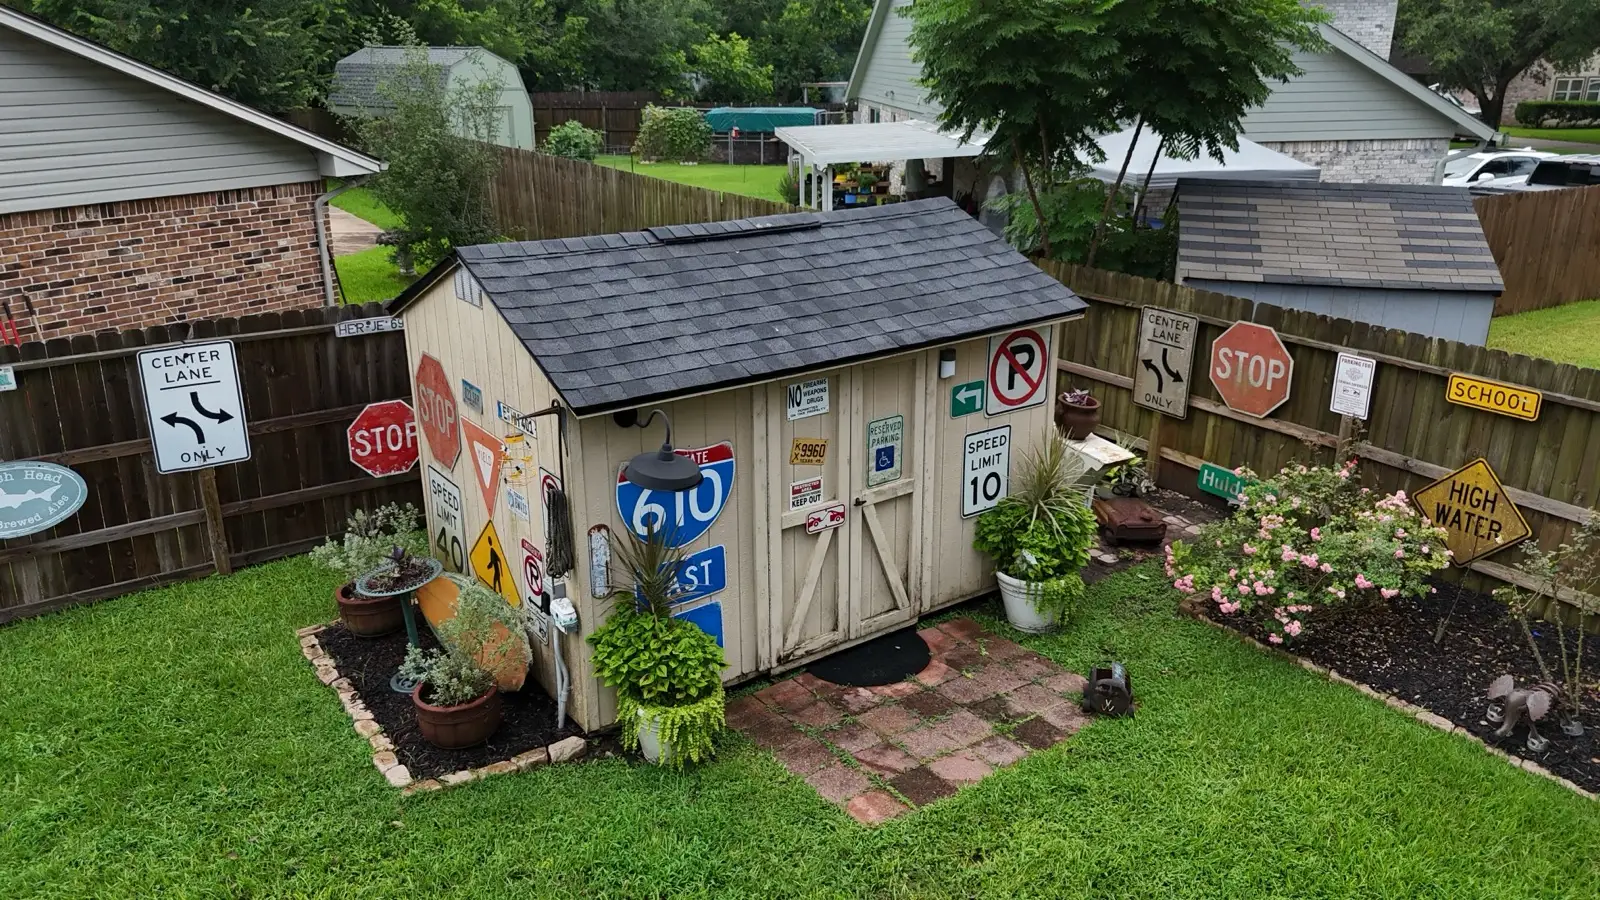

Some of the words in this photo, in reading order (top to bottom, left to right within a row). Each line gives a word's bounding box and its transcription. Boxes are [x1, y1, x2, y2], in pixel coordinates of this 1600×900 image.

[338, 322, 364, 336] HER
[1148, 314, 1190, 332] CENTER
[1152, 328, 1181, 344] LANE
[152, 350, 220, 369] CENTER
[1216, 347, 1285, 391] STOP
[165, 366, 212, 383] LANE
[802, 378, 827, 389] FIREARMS
[788, 385, 802, 409] NO
[802, 387, 827, 397] WEAPONS
[806, 396, 824, 405] DRUGS
[1144, 393, 1173, 409] ONLY
[1454, 382, 1532, 413] SCHOOL
[419, 383, 455, 439] STOP
[870, 421, 902, 436] RESERVED
[354, 421, 418, 457] STOP
[871, 433, 900, 448] PARKING
[968, 434, 1007, 454] SPEED
[180, 446, 226, 463] ONLY
[800, 443, 826, 458] 9960
[971, 453, 1002, 471] LIMIT
[23, 470, 63, 484] Head
[1202, 469, 1244, 496] Huld
[432, 480, 459, 512] SPEED
[971, 471, 1001, 506] 10
[1449, 480, 1498, 514] HIGH
[48, 495, 69, 516] Ales
[632, 469, 723, 536] 610
[791, 497, 808, 508] KEEP
[808, 494, 821, 504] OUT
[436, 501, 457, 531] LIMIT
[1436, 502, 1502, 541] WATER
[436, 526, 464, 574] 40
